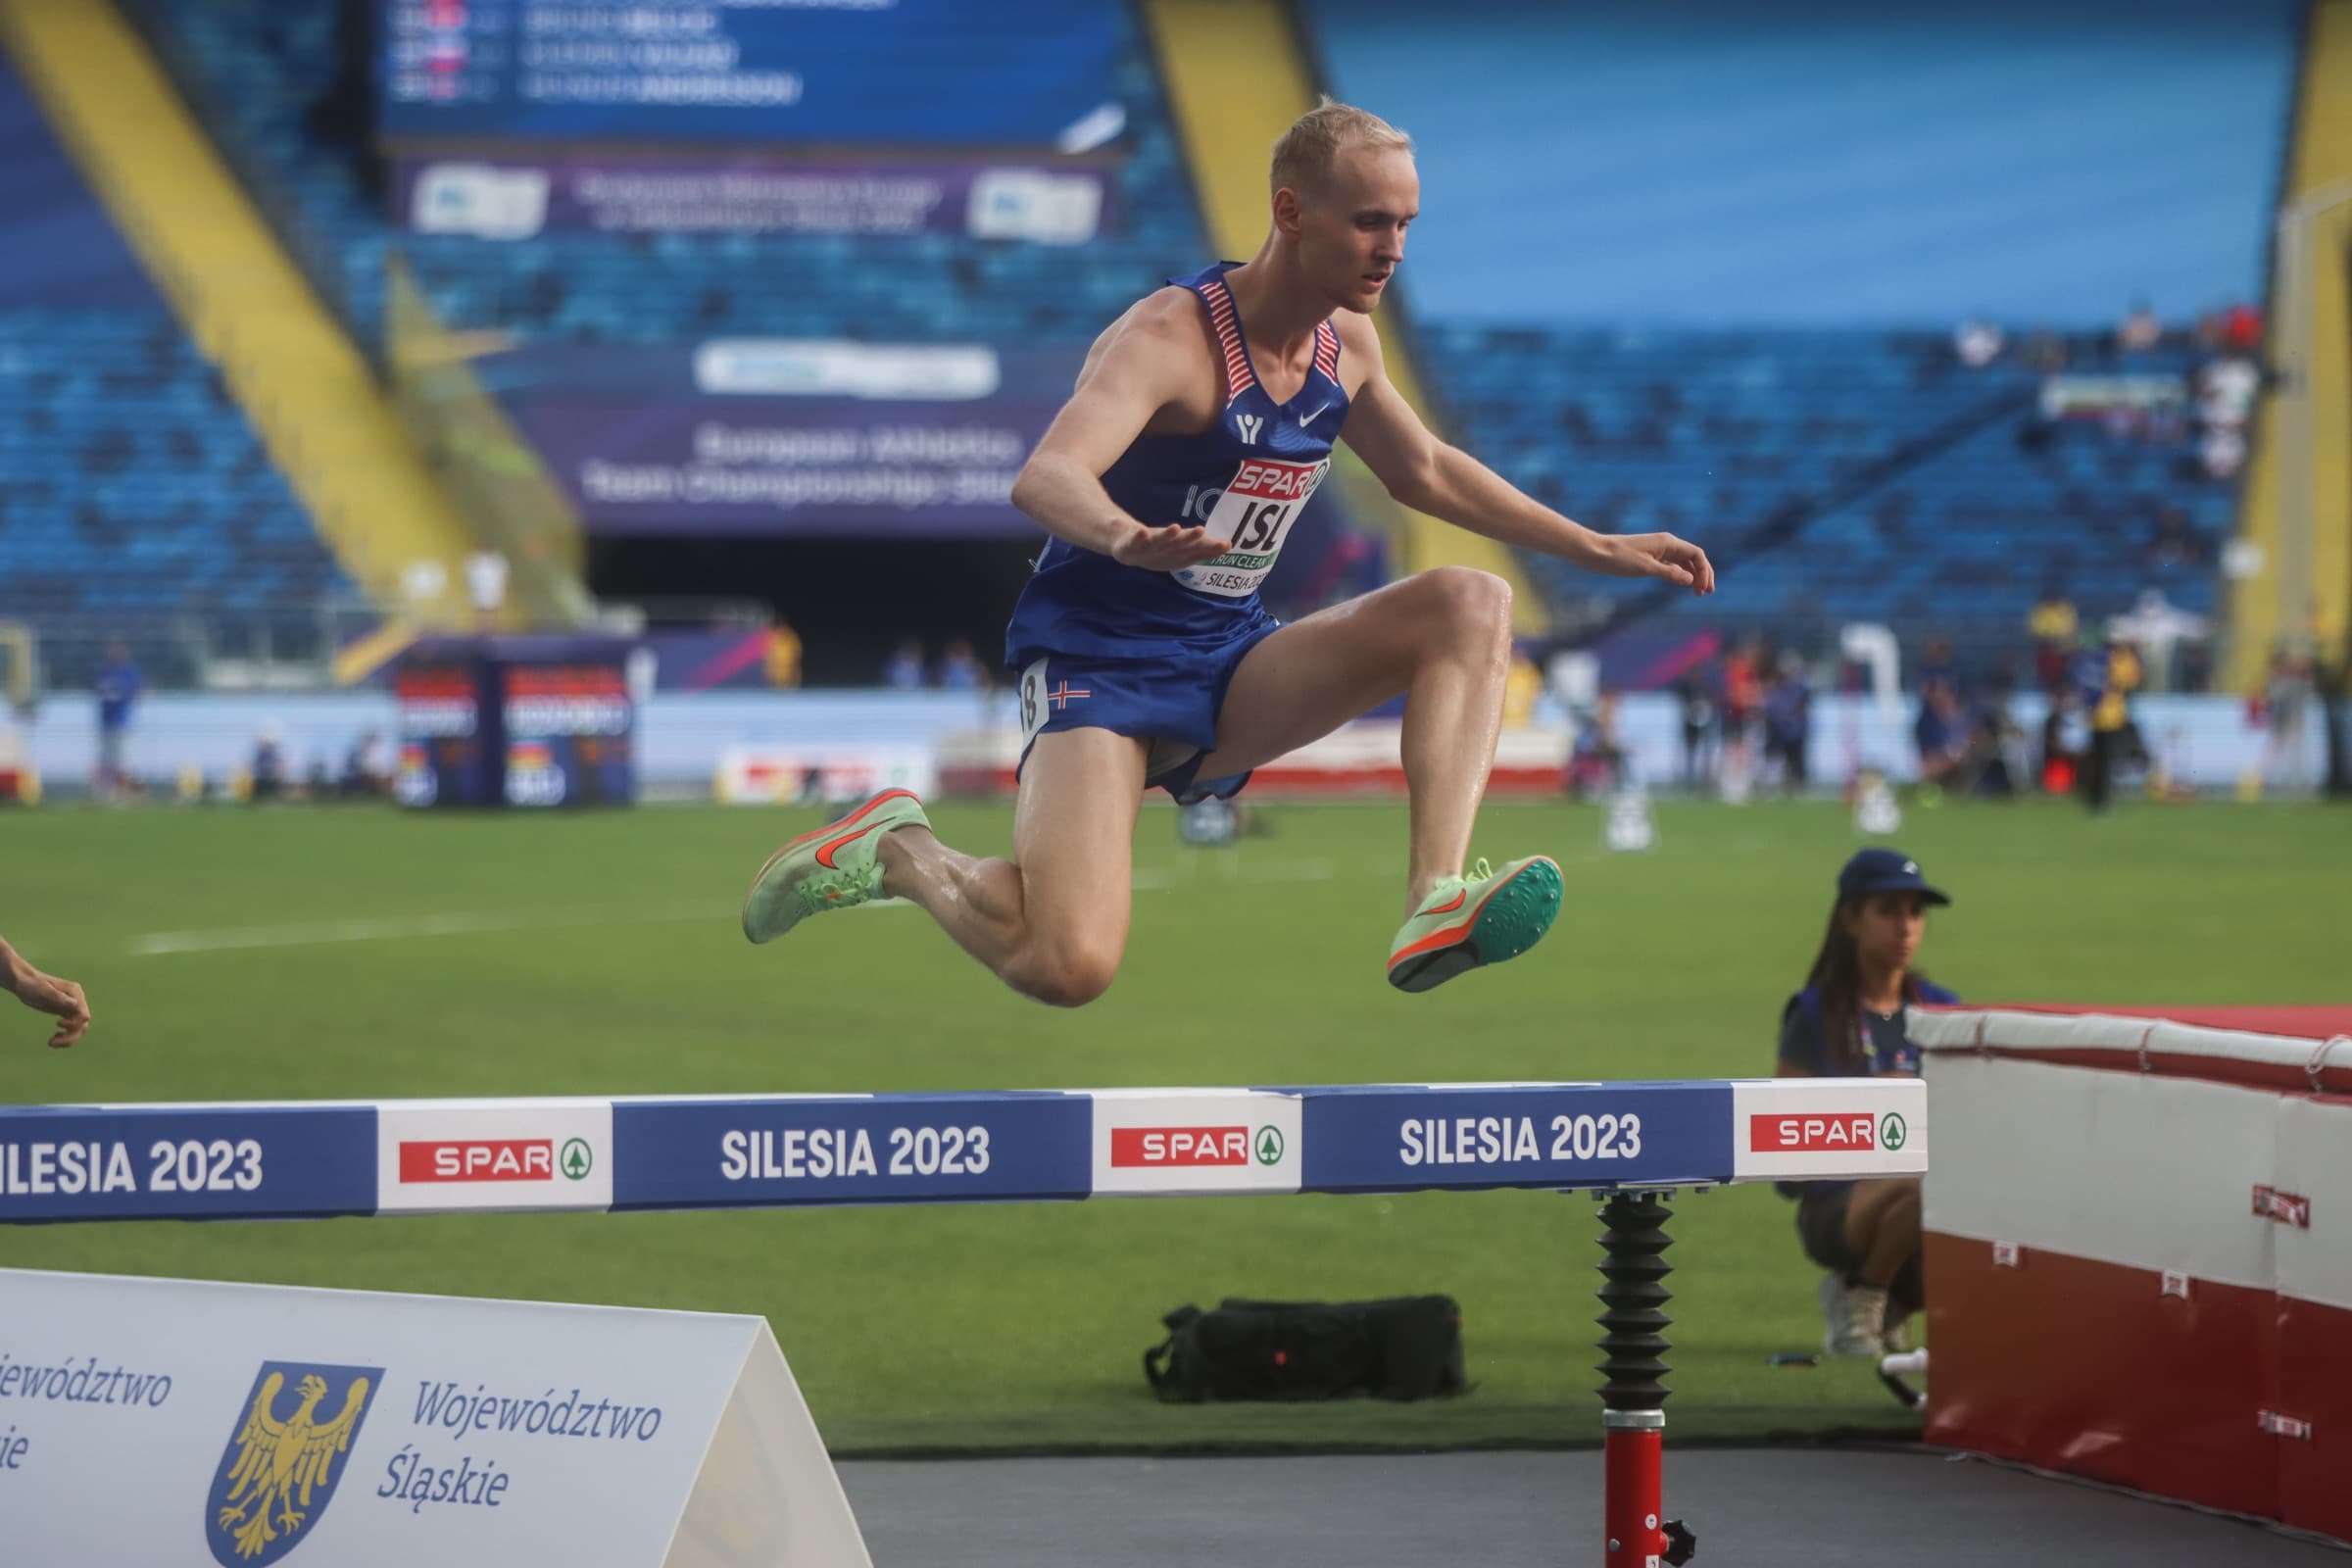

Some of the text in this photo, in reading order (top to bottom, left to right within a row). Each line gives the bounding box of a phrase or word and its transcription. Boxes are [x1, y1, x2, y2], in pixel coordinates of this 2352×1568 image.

[1235, 466, 1311, 495] SPAR
[1231, 501, 1292, 552] ISL
[1215, 555, 1240, 565] RUN
[1206, 572, 1250, 590] SILESIA
[1142, 1131, 1248, 1161] SPAR
[1399, 1114, 1642, 1165] SILESIA 2023
[1779, 1118, 1873, 1146] SPAR
[149, 1140, 263, 1192] 2023
[433, 1145, 552, 1176] SPAR
[721, 1126, 991, 1180] SILESIA 2023
[413, 1379, 662, 1442] Województwo
[376, 1444, 510, 1514] Śląskie
